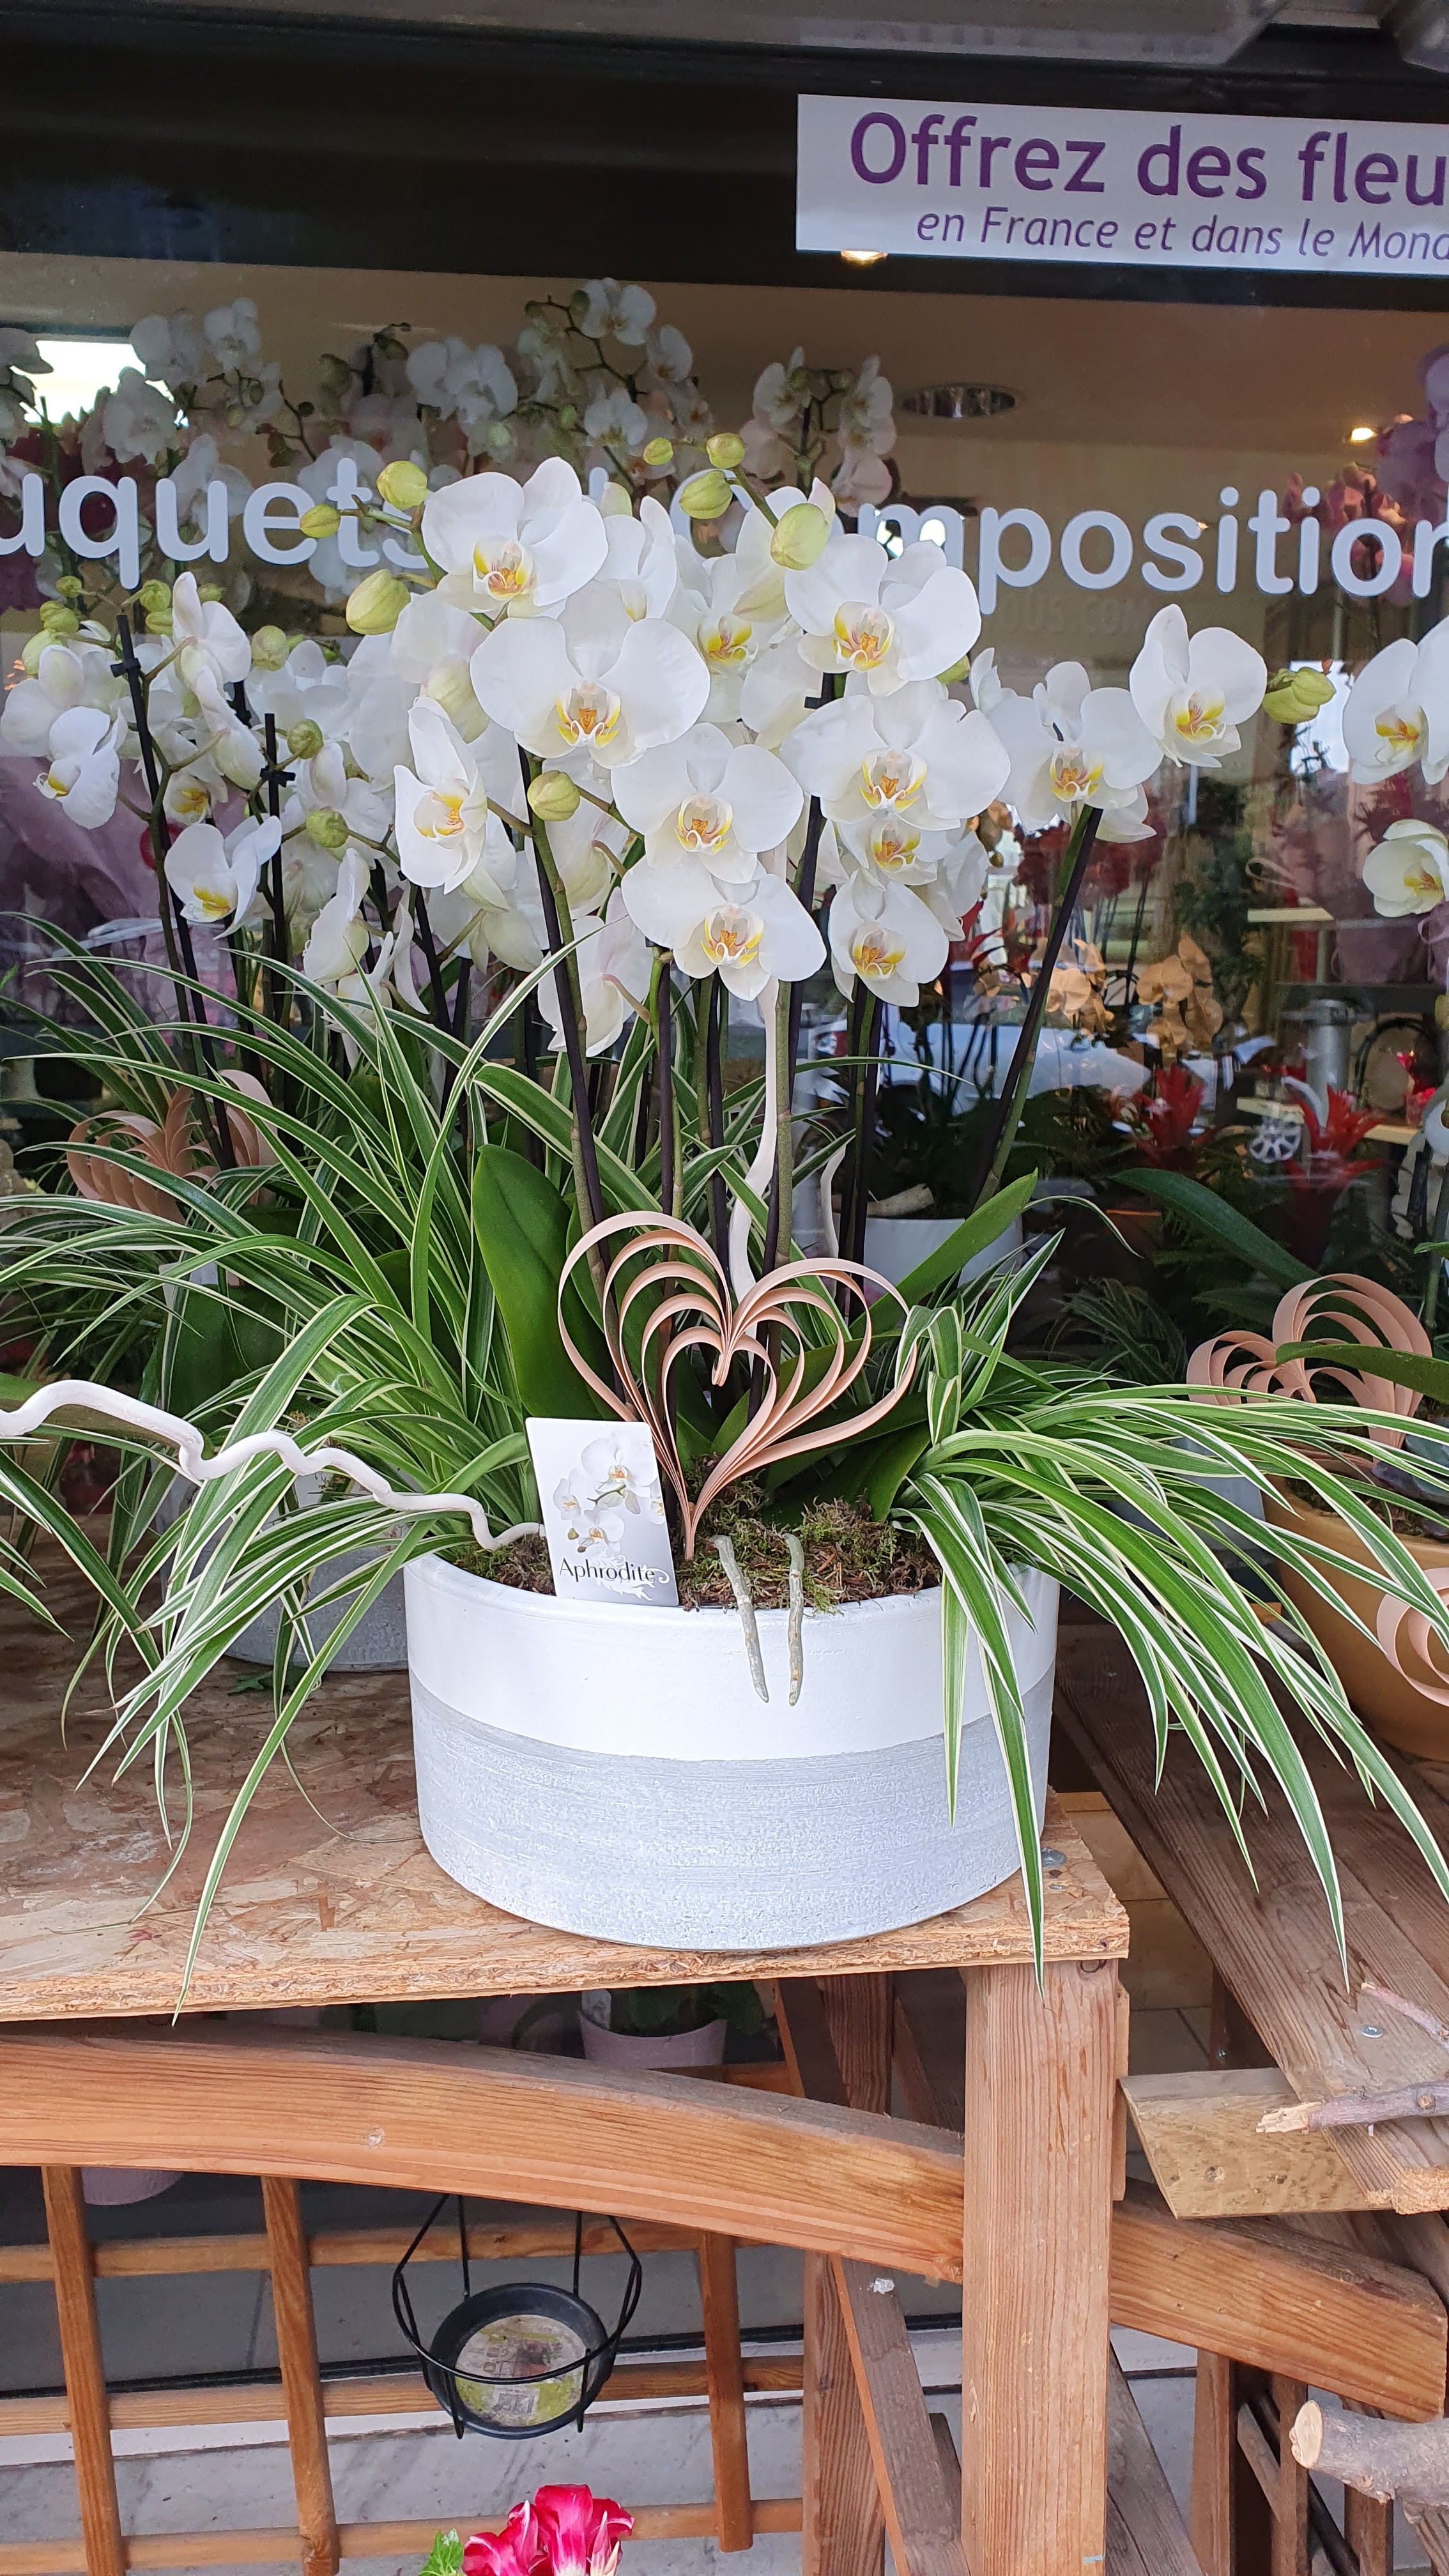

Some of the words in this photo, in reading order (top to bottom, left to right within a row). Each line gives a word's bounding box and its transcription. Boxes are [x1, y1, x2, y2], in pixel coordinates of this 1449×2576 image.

[850, 111, 1106, 193] Offrez
[1137, 125, 1267, 199] des
[1298, 130, 1447, 206] fleu
[917, 212, 964, 242] en
[980, 206, 1119, 248] France
[1134, 217, 1175, 251] et
[1191, 215, 1283, 255] dans
[1299, 217, 1335, 257] le
[559, 1557, 656, 1583] Aphrodite
